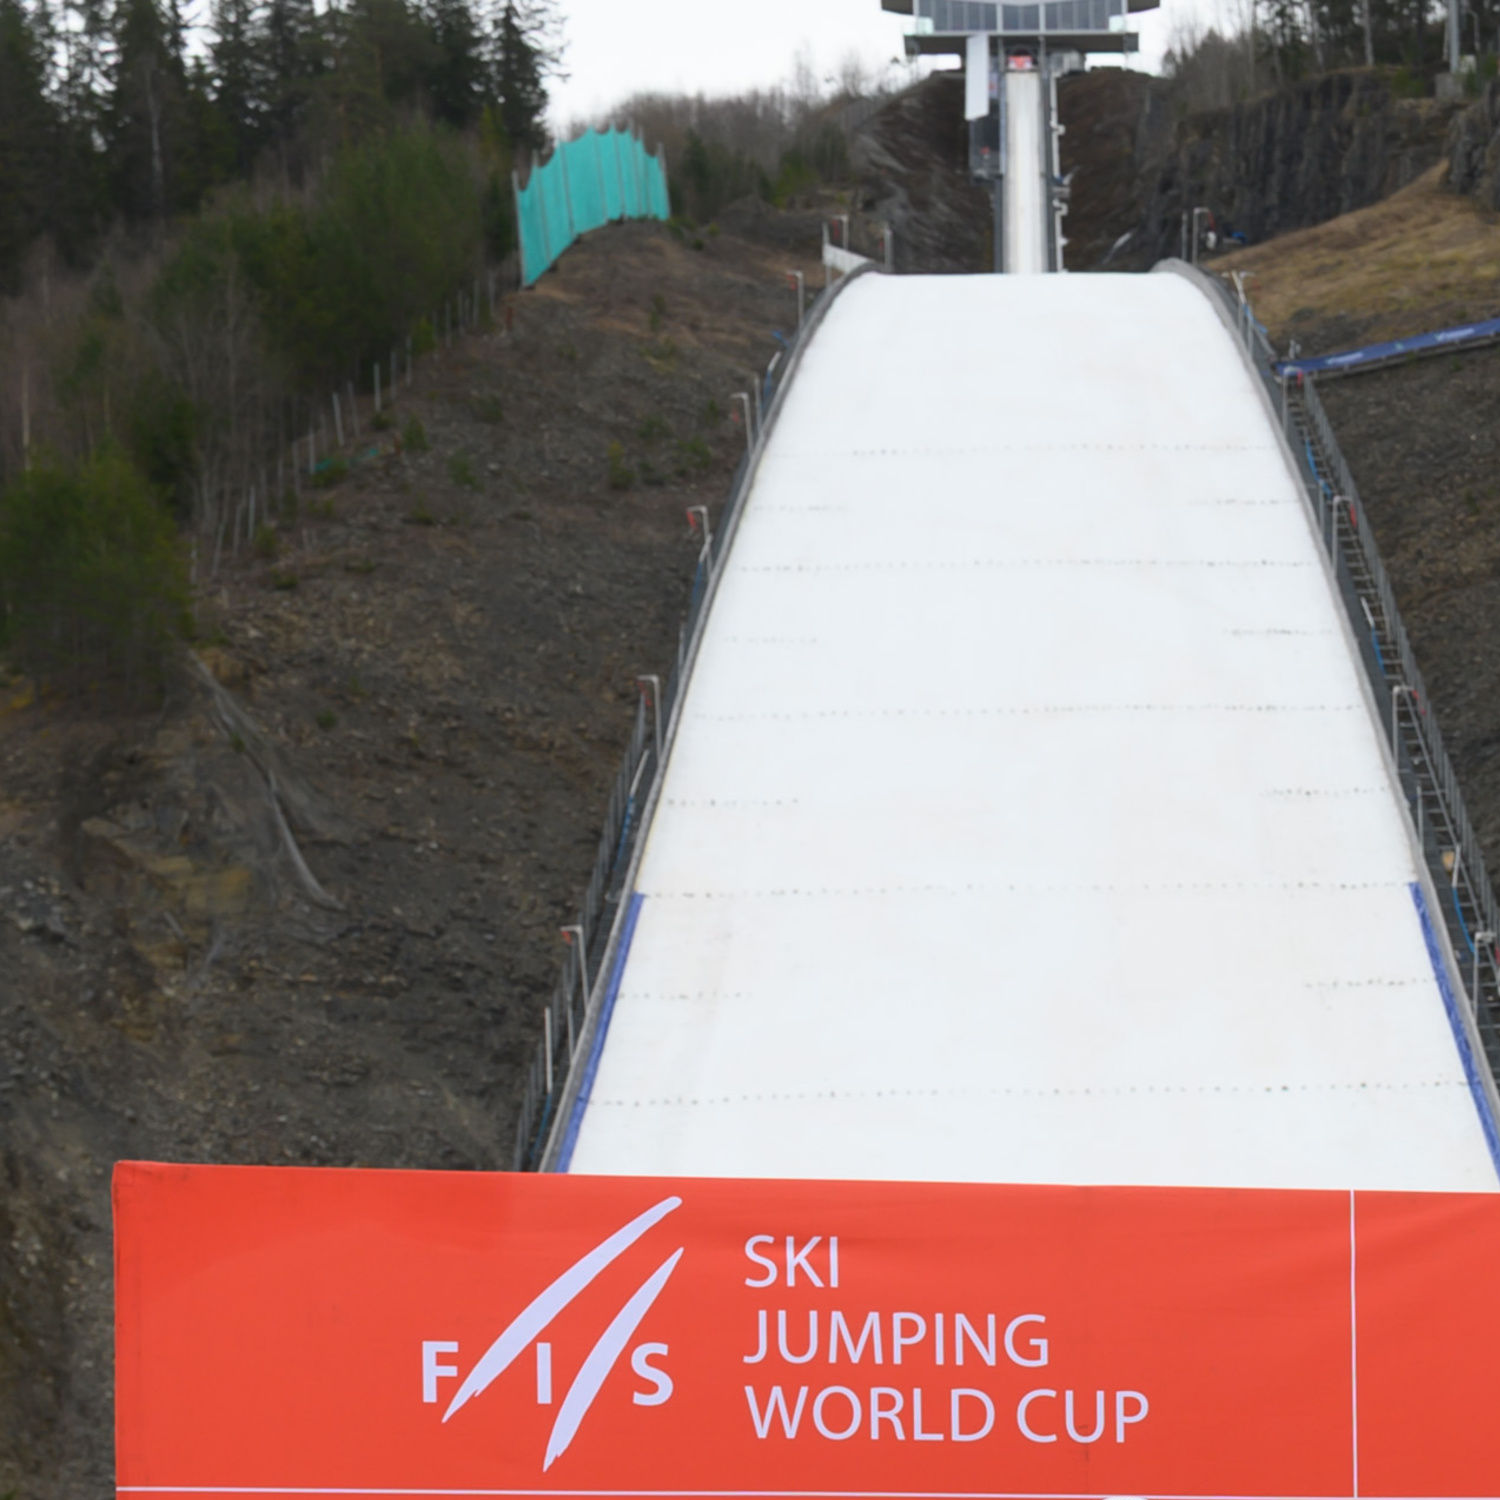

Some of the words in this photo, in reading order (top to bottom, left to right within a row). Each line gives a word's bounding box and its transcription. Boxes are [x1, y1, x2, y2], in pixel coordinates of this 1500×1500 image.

[743, 1235, 840, 1288] SKI
[743, 1310, 1050, 1368] JUMPING
[744, 1385, 995, 1442] WORLD
[1016, 1389, 1149, 1444] CUP
